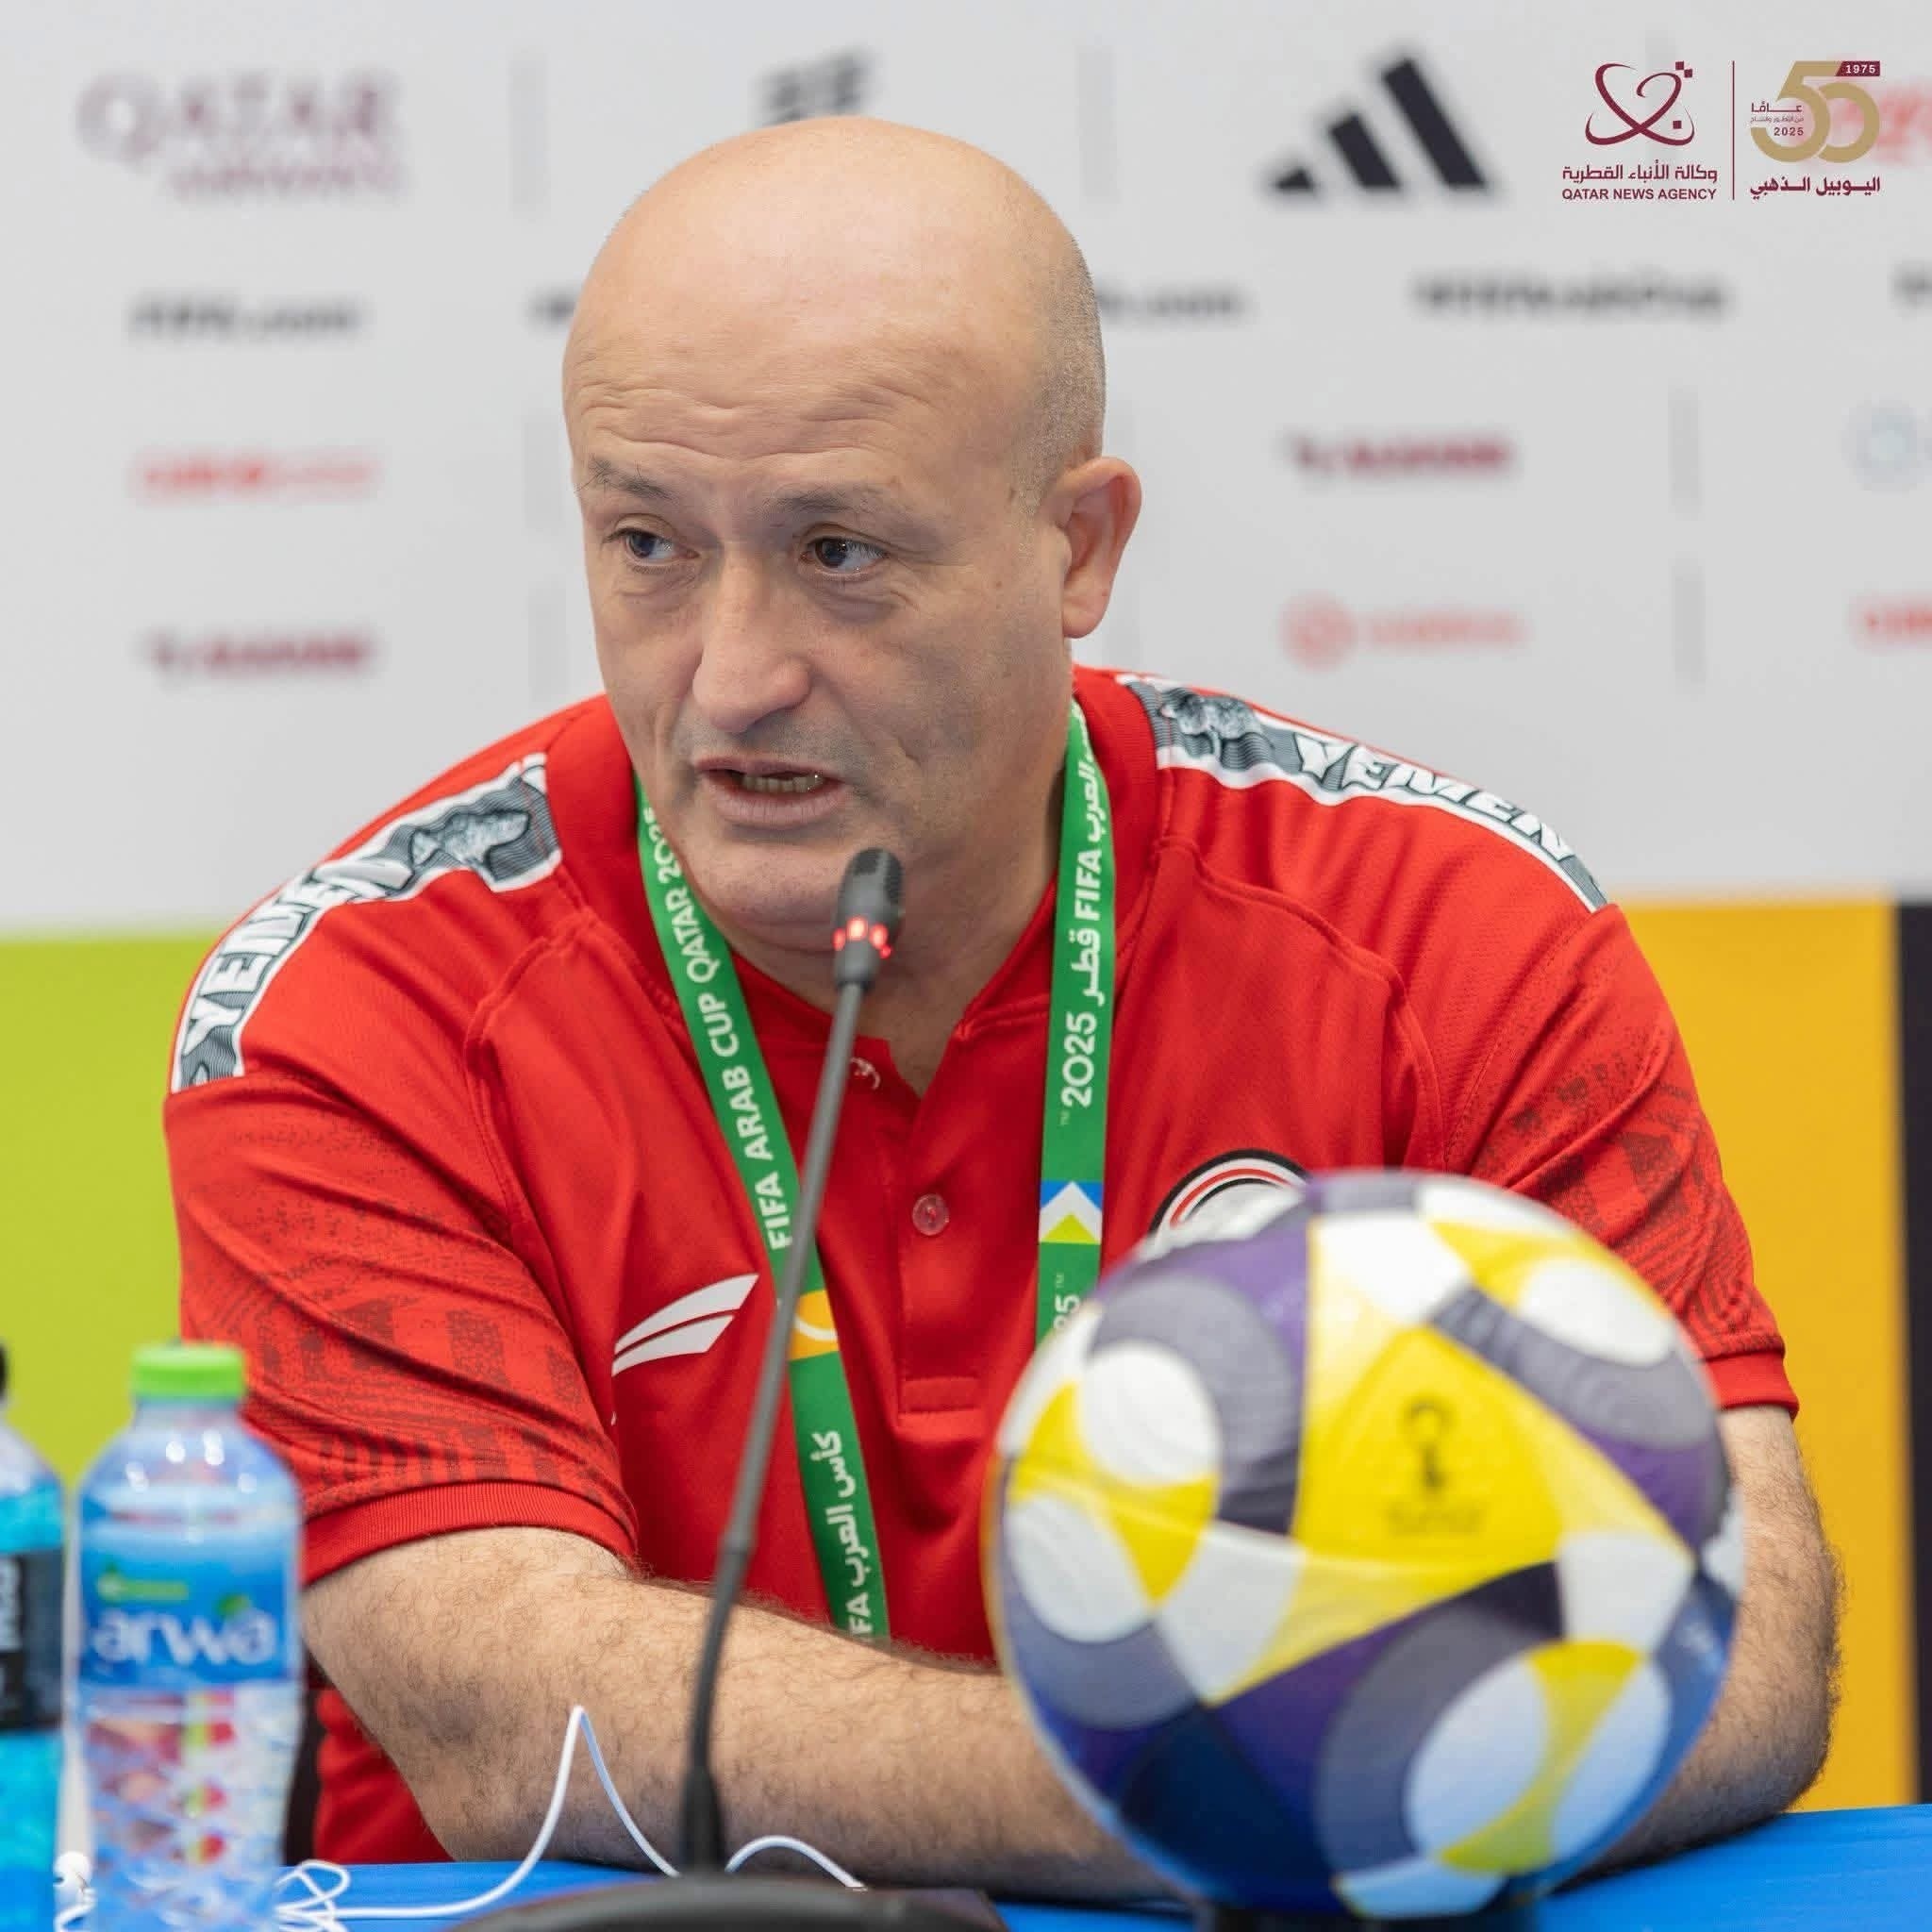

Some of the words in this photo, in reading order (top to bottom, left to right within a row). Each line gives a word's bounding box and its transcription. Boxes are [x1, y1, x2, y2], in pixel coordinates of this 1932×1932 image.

[1077, 760, 1107, 843] العرب
[1294, 731, 1575, 861] YEMEN
[1074, 849, 1103, 922] FIFA
[664, 886, 721, 983] QATAR
[1068, 927, 1106, 1008] قطر
[698, 993, 740, 1058] CUP
[1060, 1011, 1098, 1108] 2025
[722, 1065, 774, 1161] ARAB
[755, 1171, 793, 1250] FIFA
[810, 1429, 857, 1498] كأس
[825, 1504, 871, 1588] العرب
[92, 1608, 276, 1665] arwa
[845, 1591, 874, 1636] FA
